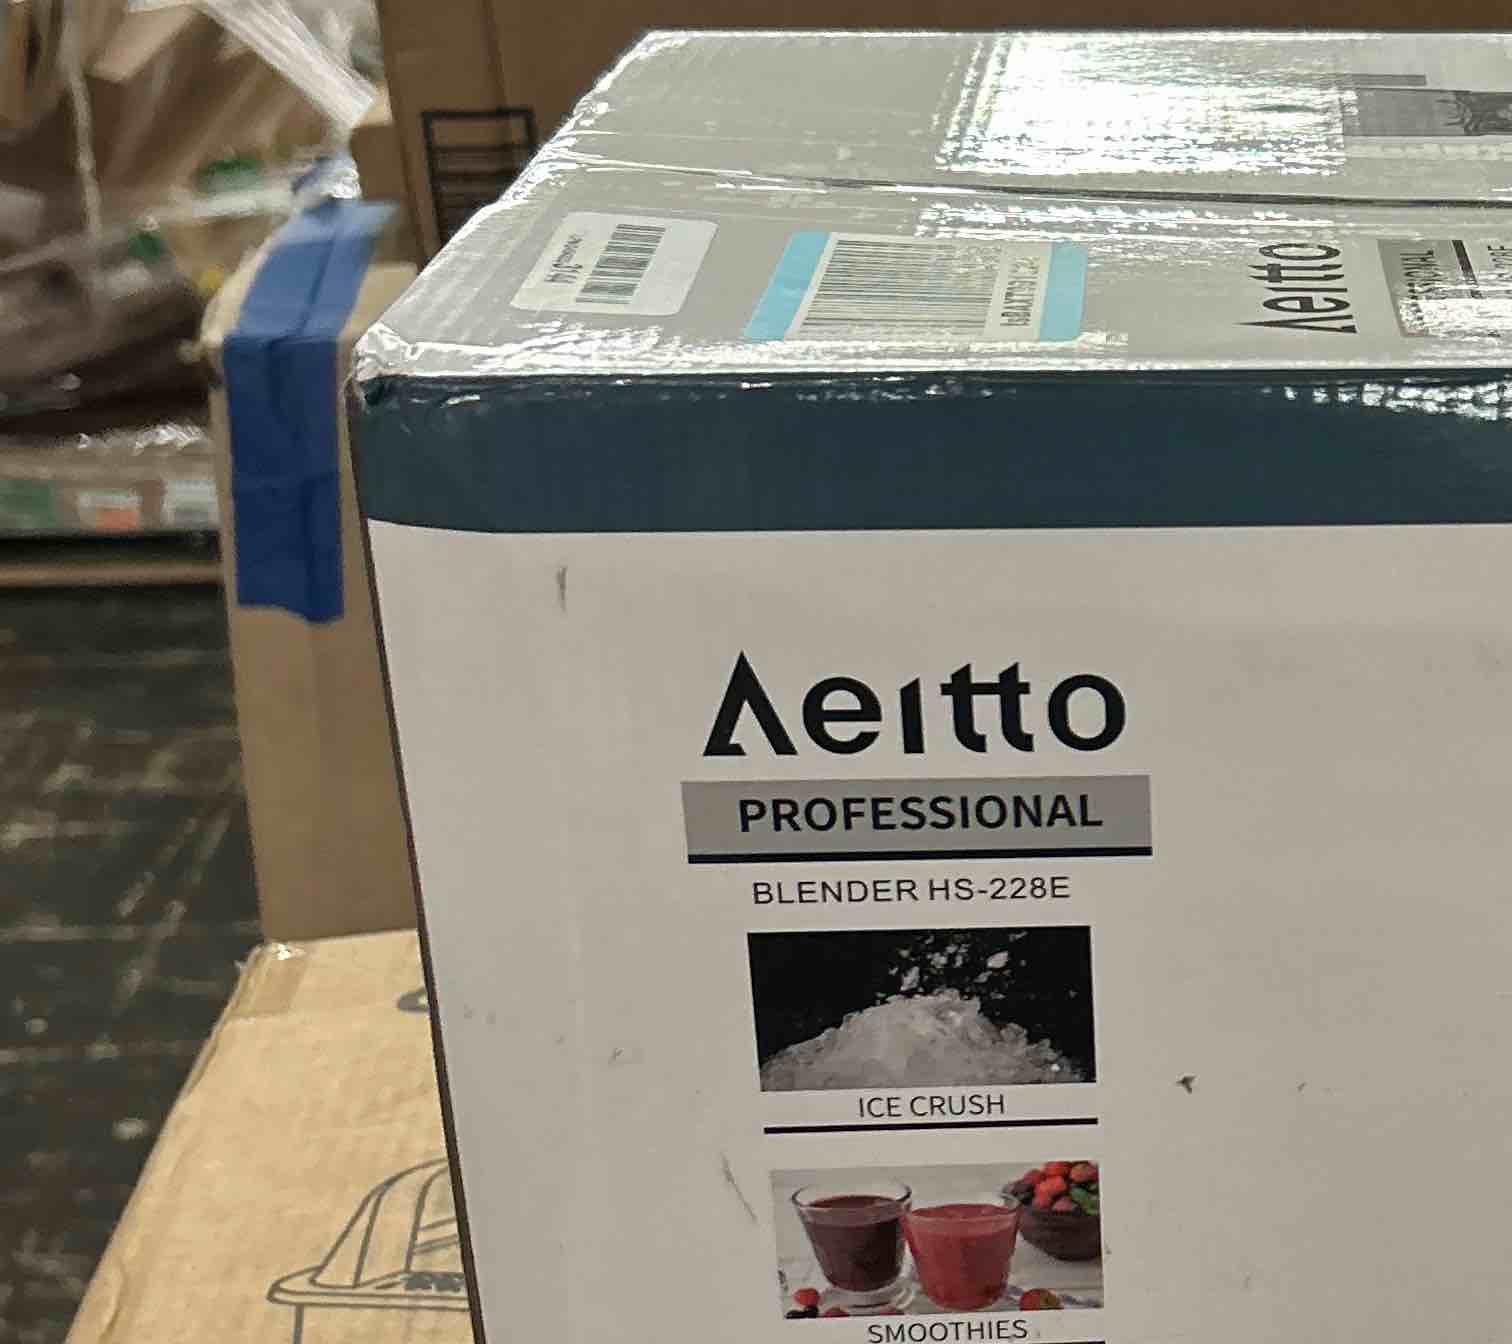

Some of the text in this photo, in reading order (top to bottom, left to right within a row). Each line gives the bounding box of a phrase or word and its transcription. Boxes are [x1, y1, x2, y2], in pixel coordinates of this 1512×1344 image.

[702, 649, 1126, 757] Aeitto
[738, 793, 1105, 833] PROFESSIONAL
[752, 875, 1071, 905] BLENDER HS-228E
[858, 1093, 1006, 1119] ICE CRUSH
